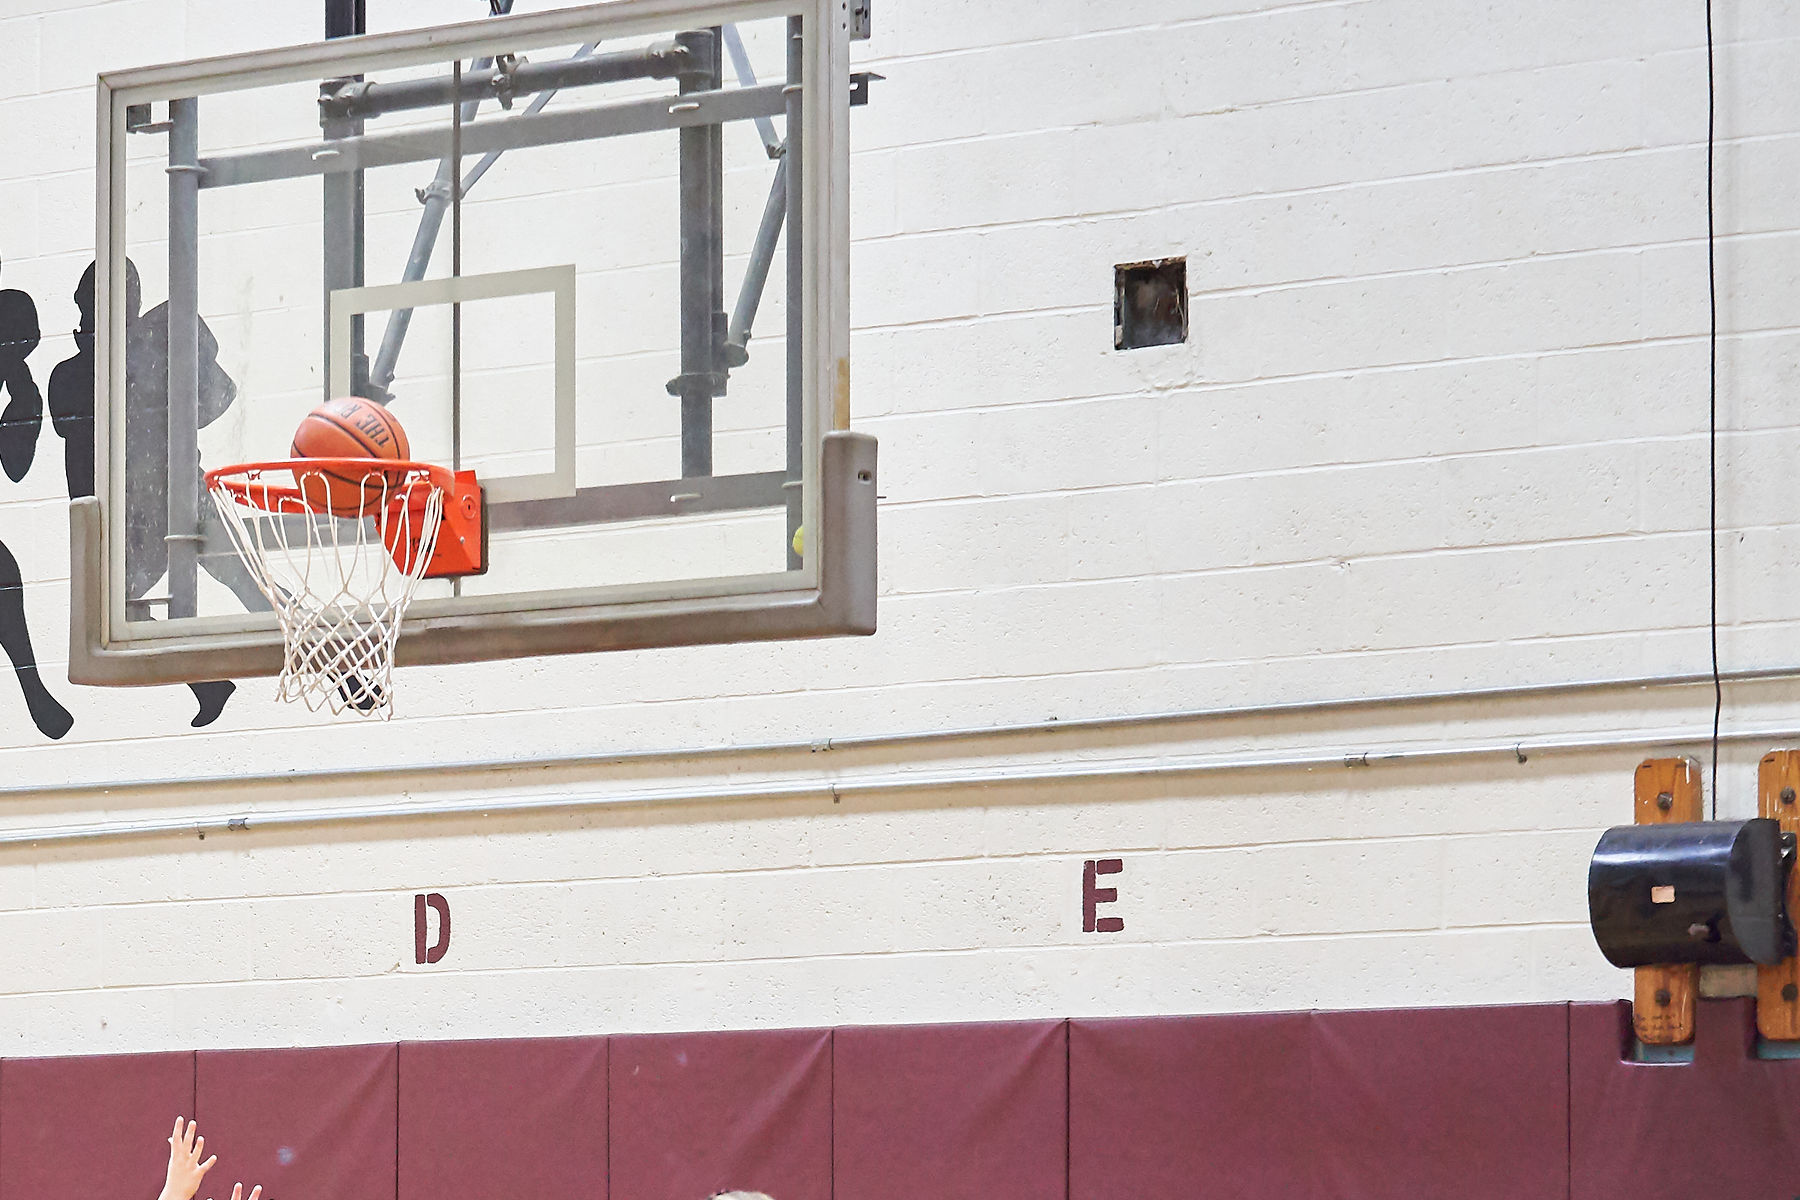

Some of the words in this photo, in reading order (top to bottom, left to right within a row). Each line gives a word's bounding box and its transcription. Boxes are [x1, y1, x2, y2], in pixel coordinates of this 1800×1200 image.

[355, 412, 390, 449] THE
[414, 892, 452, 965] D
[1082, 858, 1125, 933] E
